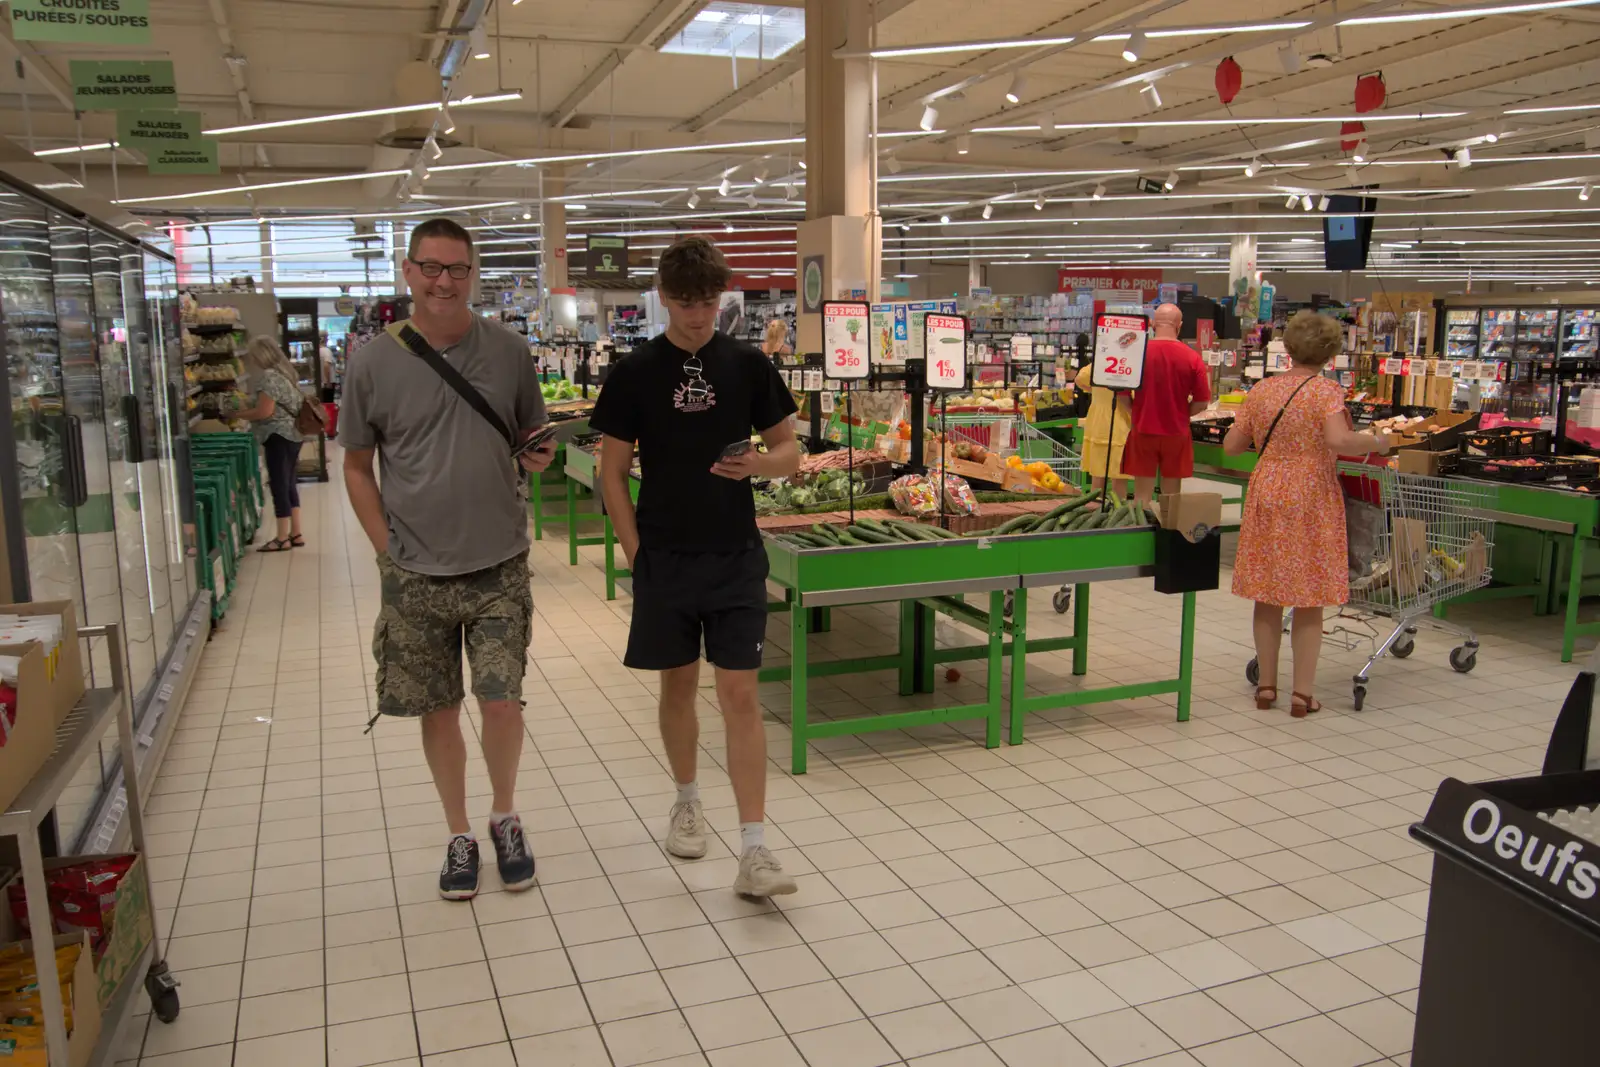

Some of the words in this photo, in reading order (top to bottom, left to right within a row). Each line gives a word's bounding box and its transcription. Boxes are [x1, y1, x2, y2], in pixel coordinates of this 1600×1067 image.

[12, 9, 77, 23] PURÉES
[85, 14, 148, 27] SOUPES
[96, 74, 151, 83] SALADES
[76, 86, 120, 95] JEUNES
[122, 86, 175, 95] POUSSES
[137, 120, 182, 129] SALADES
[1063, 277, 1113, 289] PREMIER
[1133, 279, 1159, 290] PRIX
[826, 307, 838, 315] LES
[945, 320, 964, 328] POUR
[1462, 799, 1600, 899] Oeufs
